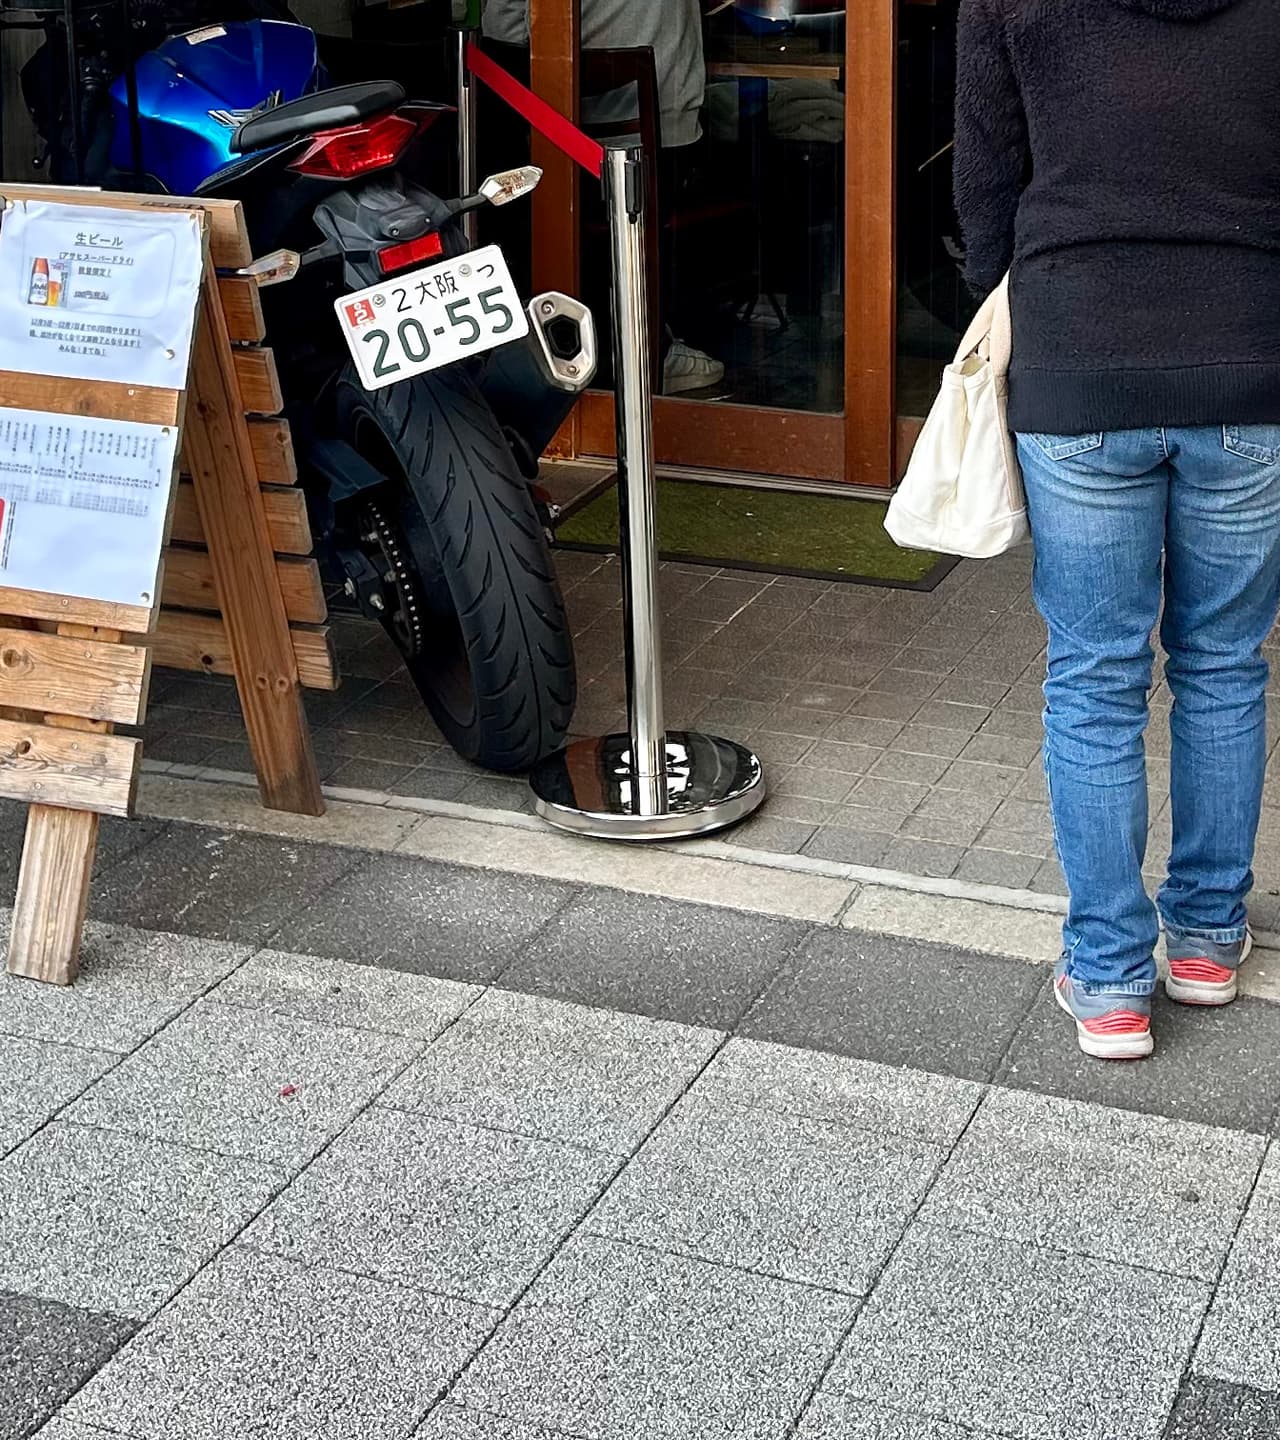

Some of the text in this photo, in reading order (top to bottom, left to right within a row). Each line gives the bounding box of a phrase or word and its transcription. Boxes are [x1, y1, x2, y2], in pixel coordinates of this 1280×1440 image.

[75, 231, 124, 247] 生ビール
[362, 284, 515, 379] 20-55
